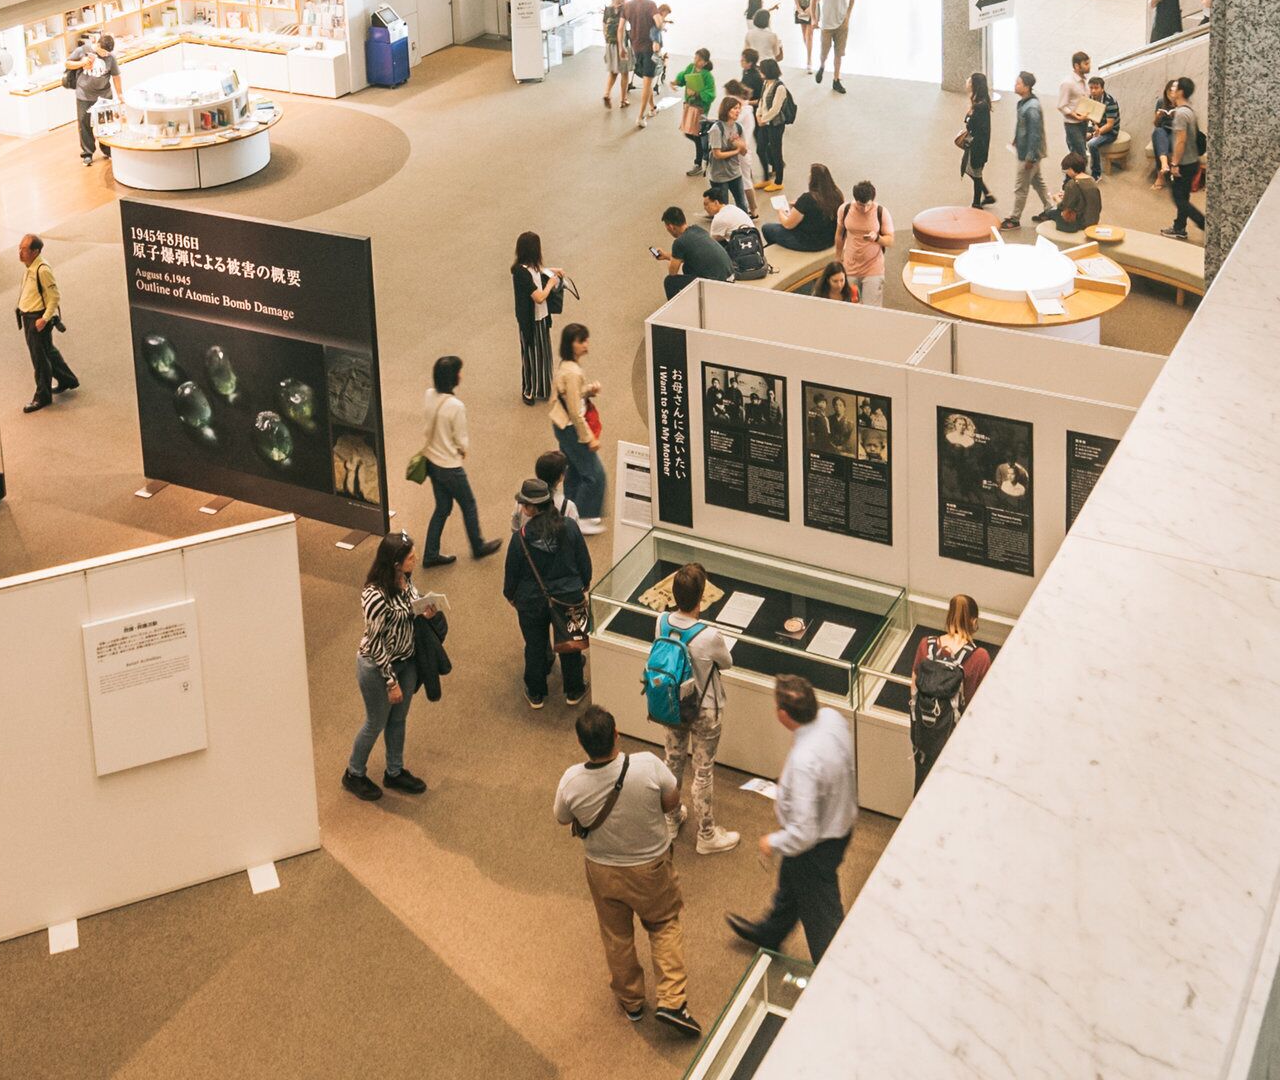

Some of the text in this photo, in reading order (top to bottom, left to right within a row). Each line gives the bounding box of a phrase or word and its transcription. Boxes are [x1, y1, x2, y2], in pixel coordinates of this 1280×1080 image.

[131, 226, 200, 251] 1945年8月6日
[133, 241, 302, 288] 原子爆弾による被害の概要
[135, 268, 163, 281] August
[136, 279, 295, 320] Outline of Atomic Bomb Damage
[660, 371, 668, 395] Want
[660, 396, 668, 407] to
[661, 408, 670, 425] See
[672, 368, 686, 480] お母さんに会いたい
[661, 426, 670, 442] My
[662, 443, 671, 477] Mother
